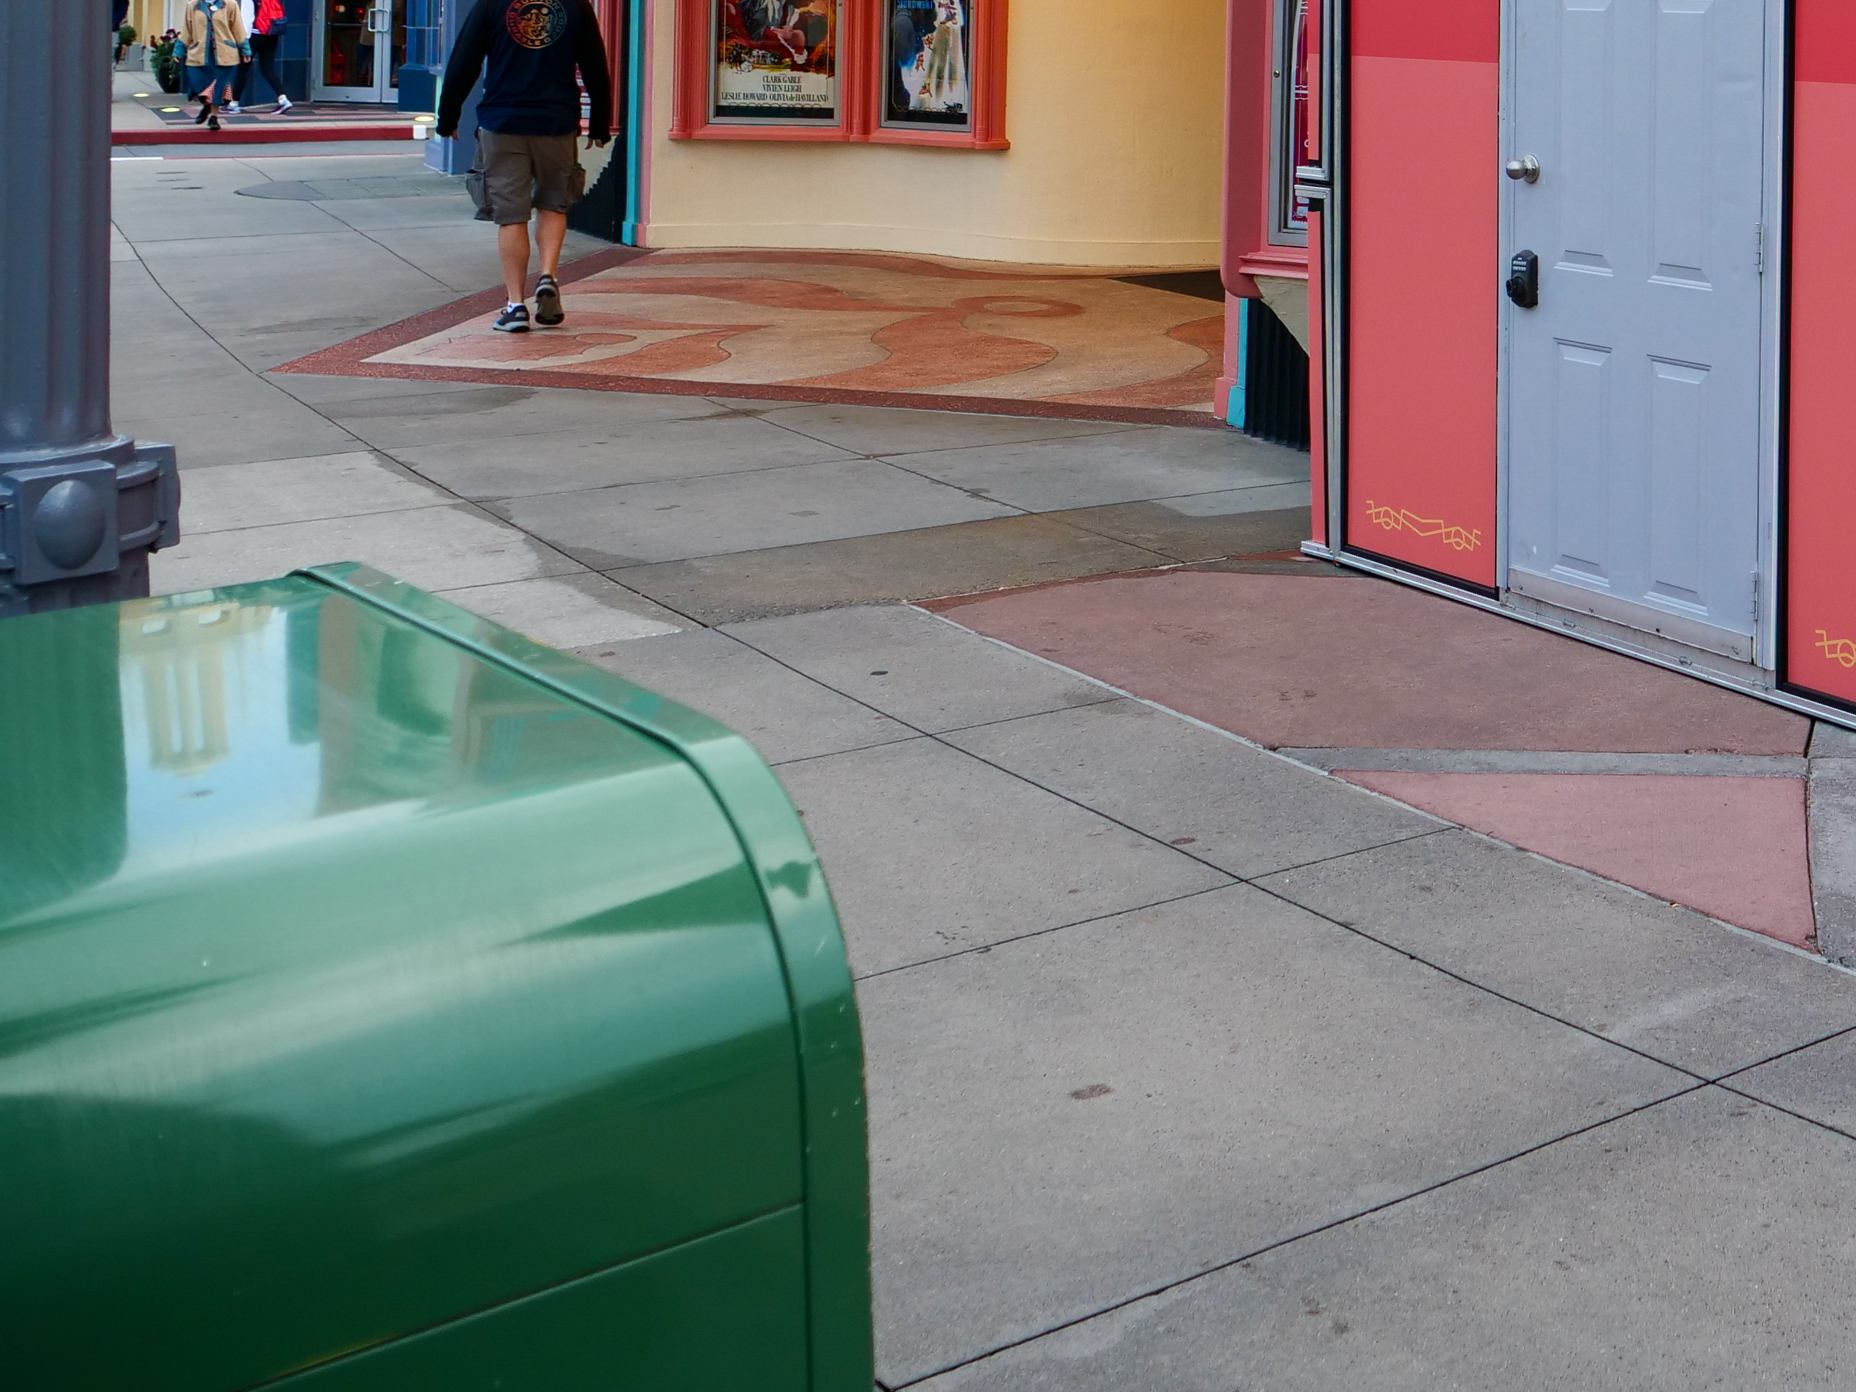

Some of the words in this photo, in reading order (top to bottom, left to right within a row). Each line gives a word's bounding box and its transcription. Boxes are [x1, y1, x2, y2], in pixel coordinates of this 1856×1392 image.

[762, 75, 782, 83] CLARK
[782, 76, 802, 84] GABLE
[762, 84, 783, 92] VIVIEN
[721, 92, 742, 100] LESLIE
[742, 93, 767, 101] HOWARD
